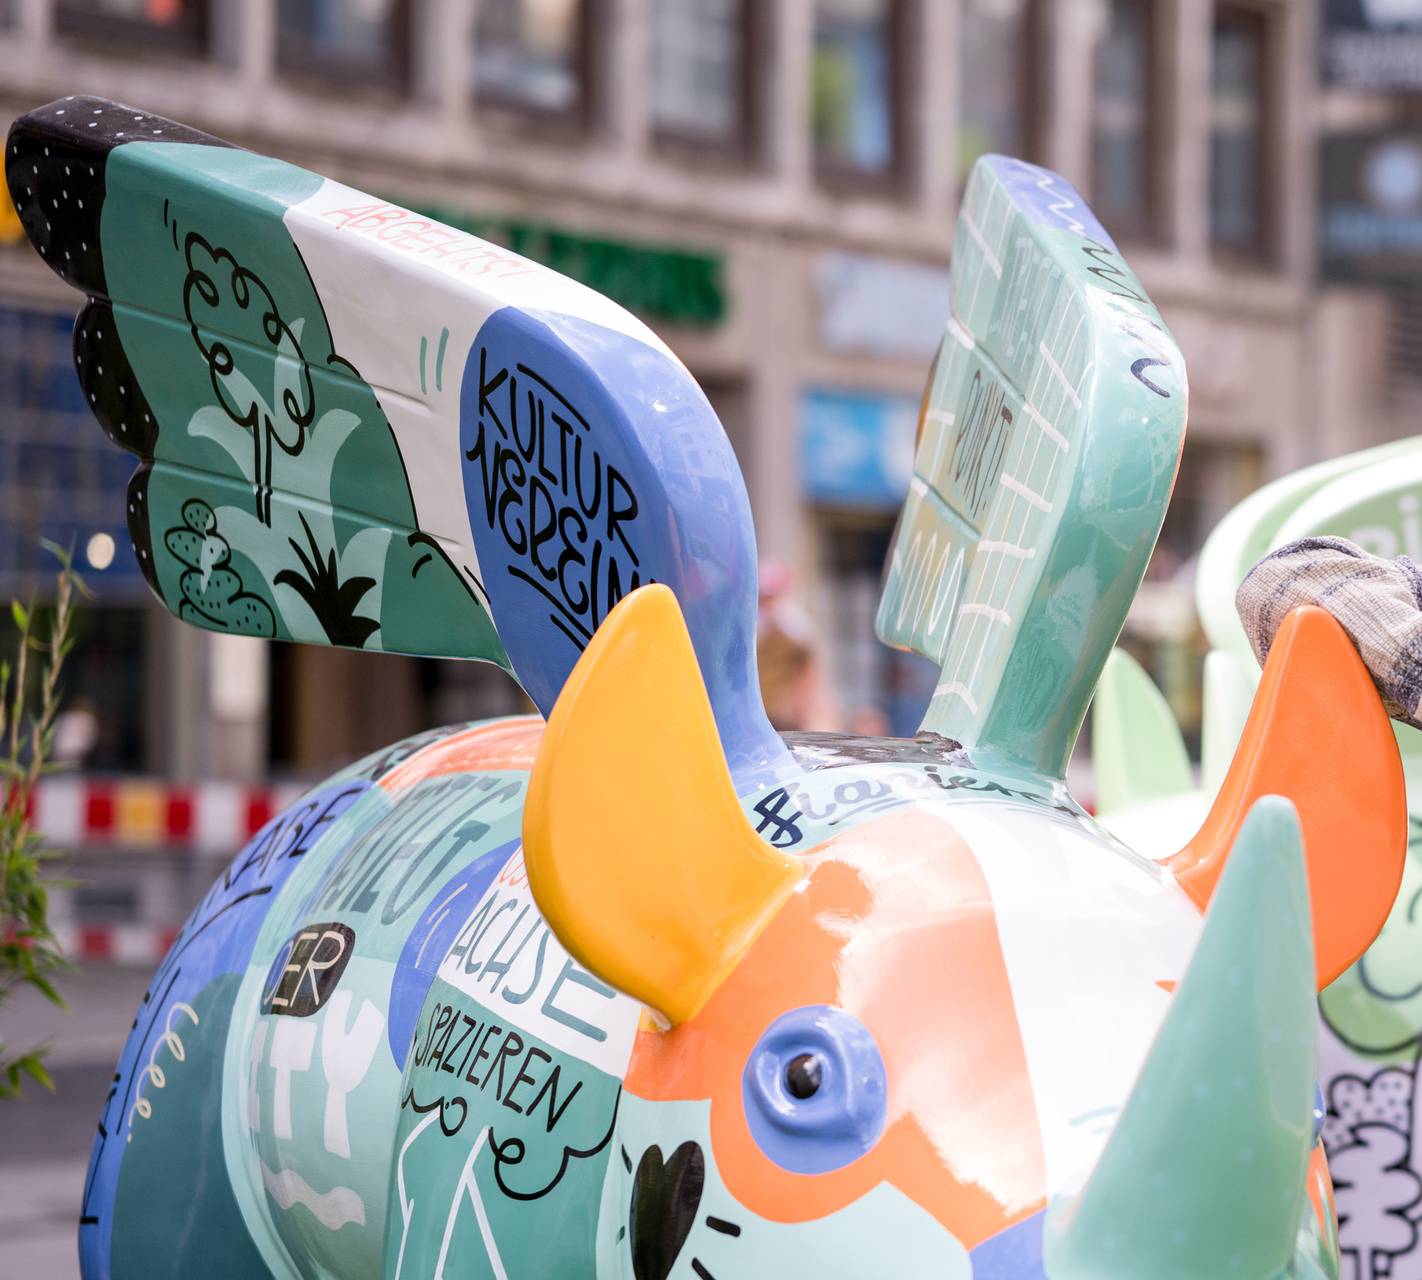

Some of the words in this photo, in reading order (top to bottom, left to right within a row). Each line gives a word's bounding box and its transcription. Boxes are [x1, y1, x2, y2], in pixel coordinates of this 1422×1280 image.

[478, 346, 640, 568] KULTUR
[443, 889, 607, 1042] ACHSE
[414, 1002, 584, 1133] SPAZIEREN
